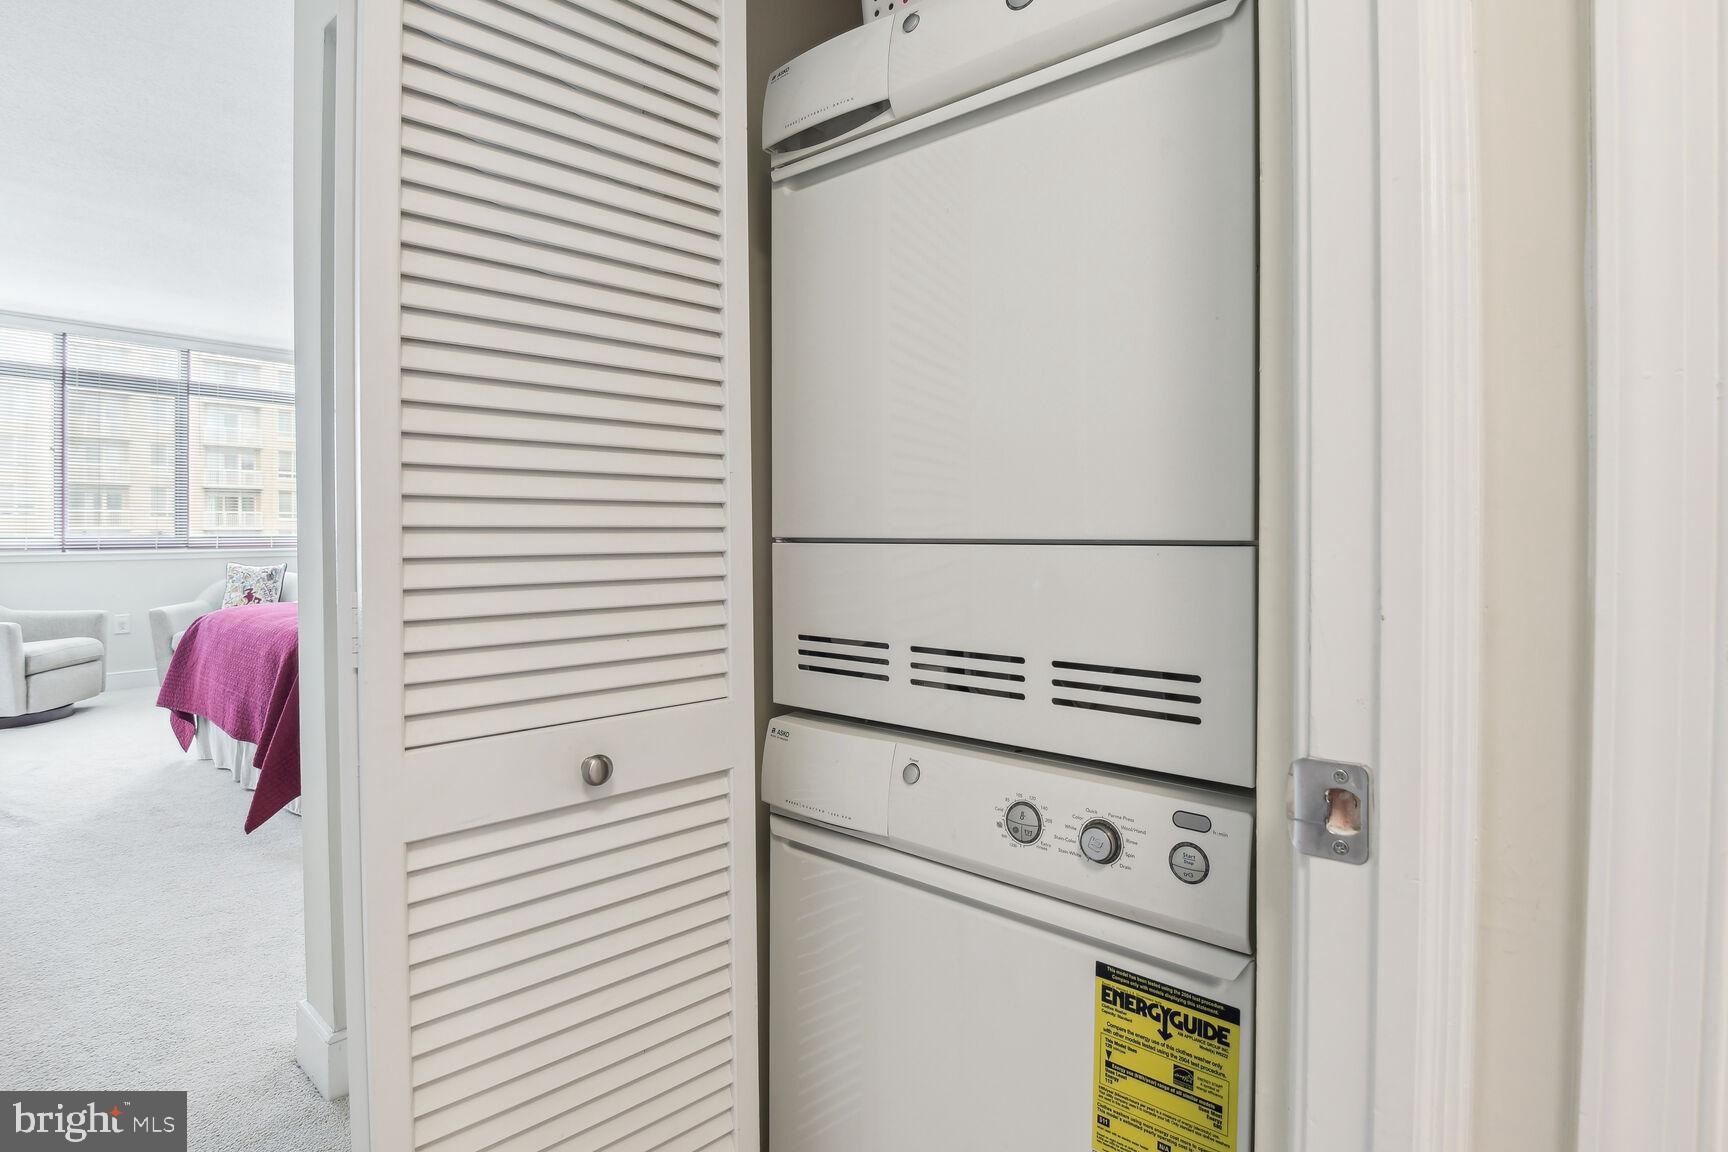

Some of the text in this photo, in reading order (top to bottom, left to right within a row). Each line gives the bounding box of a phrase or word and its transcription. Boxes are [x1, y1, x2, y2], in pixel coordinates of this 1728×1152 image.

[776, 729, 790, 738] ASKO
[1085, 807, 1098, 815] Quick
[1122, 815, 1135, 823] Press
[1064, 823, 1077, 831] White
[1069, 850, 1082, 858] White
[1119, 863, 1132, 871] Drain
[1116, 970, 1128, 978] model
[1106, 1021, 1127, 1034] Compare
[1135, 1033, 1151, 1043] energy
[1166, 1043, 1175, 1051] this
[1175, 1047, 1193, 1058] clothes
[1193, 1054, 1212, 1064] washer
[1211, 1061, 1223, 1070] only
[1113, 1031, 1124, 1039] other
[1124, 1035, 1142, 1046] models
[1141, 1041, 1156, 1051] tested
[1156, 1048, 1170, 1058] using
[1170, 1052, 1178, 1060] the
[1114, 1040, 1127, 1050] Model
